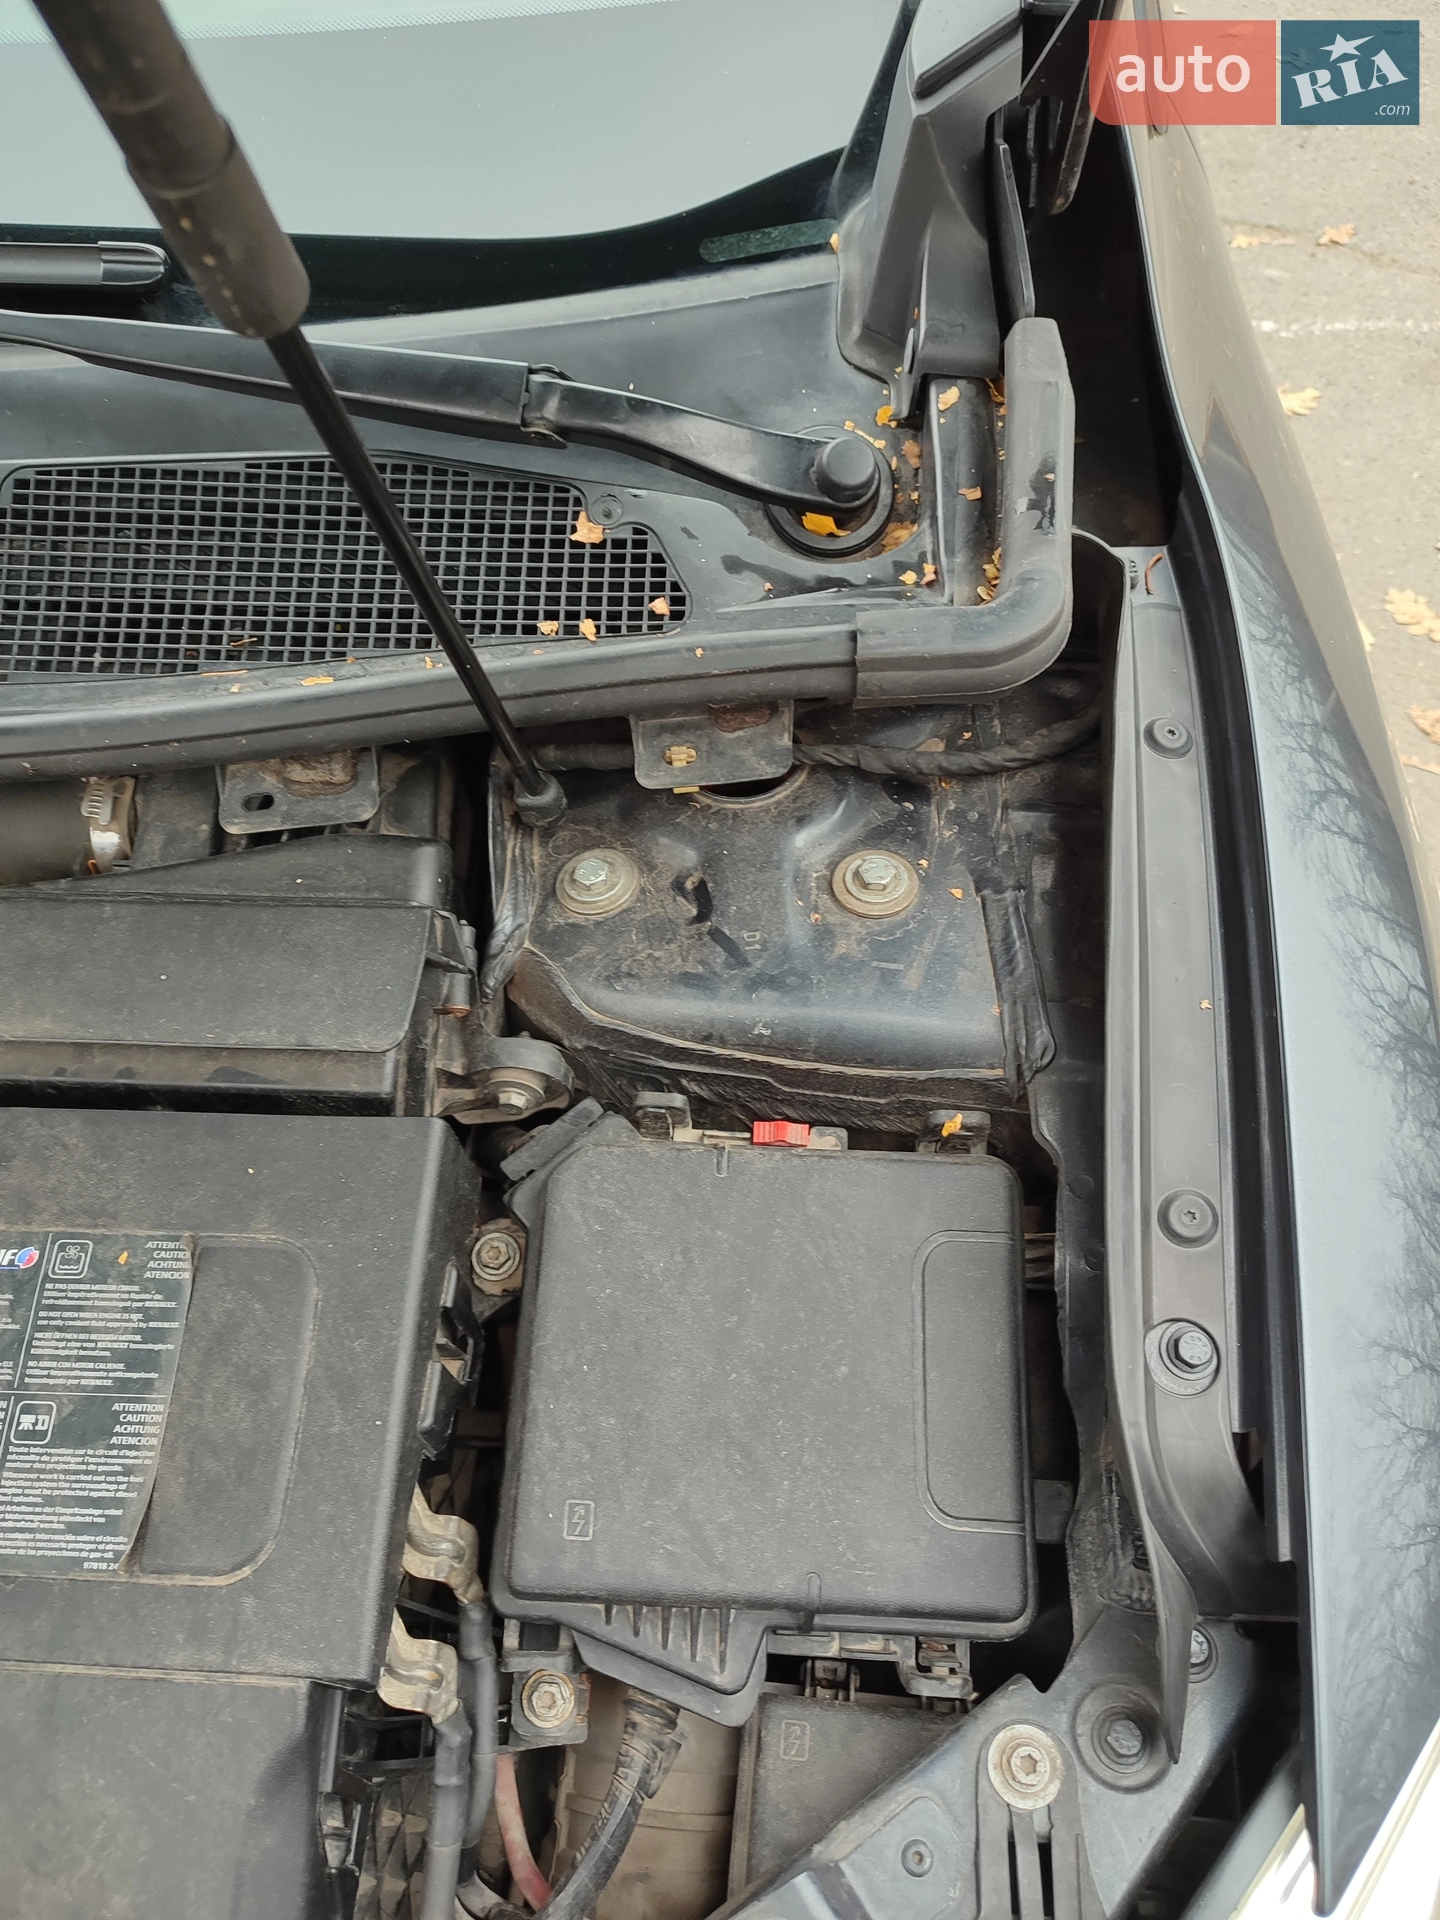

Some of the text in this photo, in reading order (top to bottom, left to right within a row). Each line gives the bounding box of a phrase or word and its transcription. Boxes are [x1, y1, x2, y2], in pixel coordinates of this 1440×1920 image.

[153, 1250, 188, 1259] CAUTIO
[111, 1403, 164, 1412] ATTENTION
[119, 1413, 162, 1423] CAUTION
[113, 1424, 161, 1434] ACHTUNG
[110, 1436, 158, 1445] ATENCION
[83, 1562, 108, 1570] 97818
